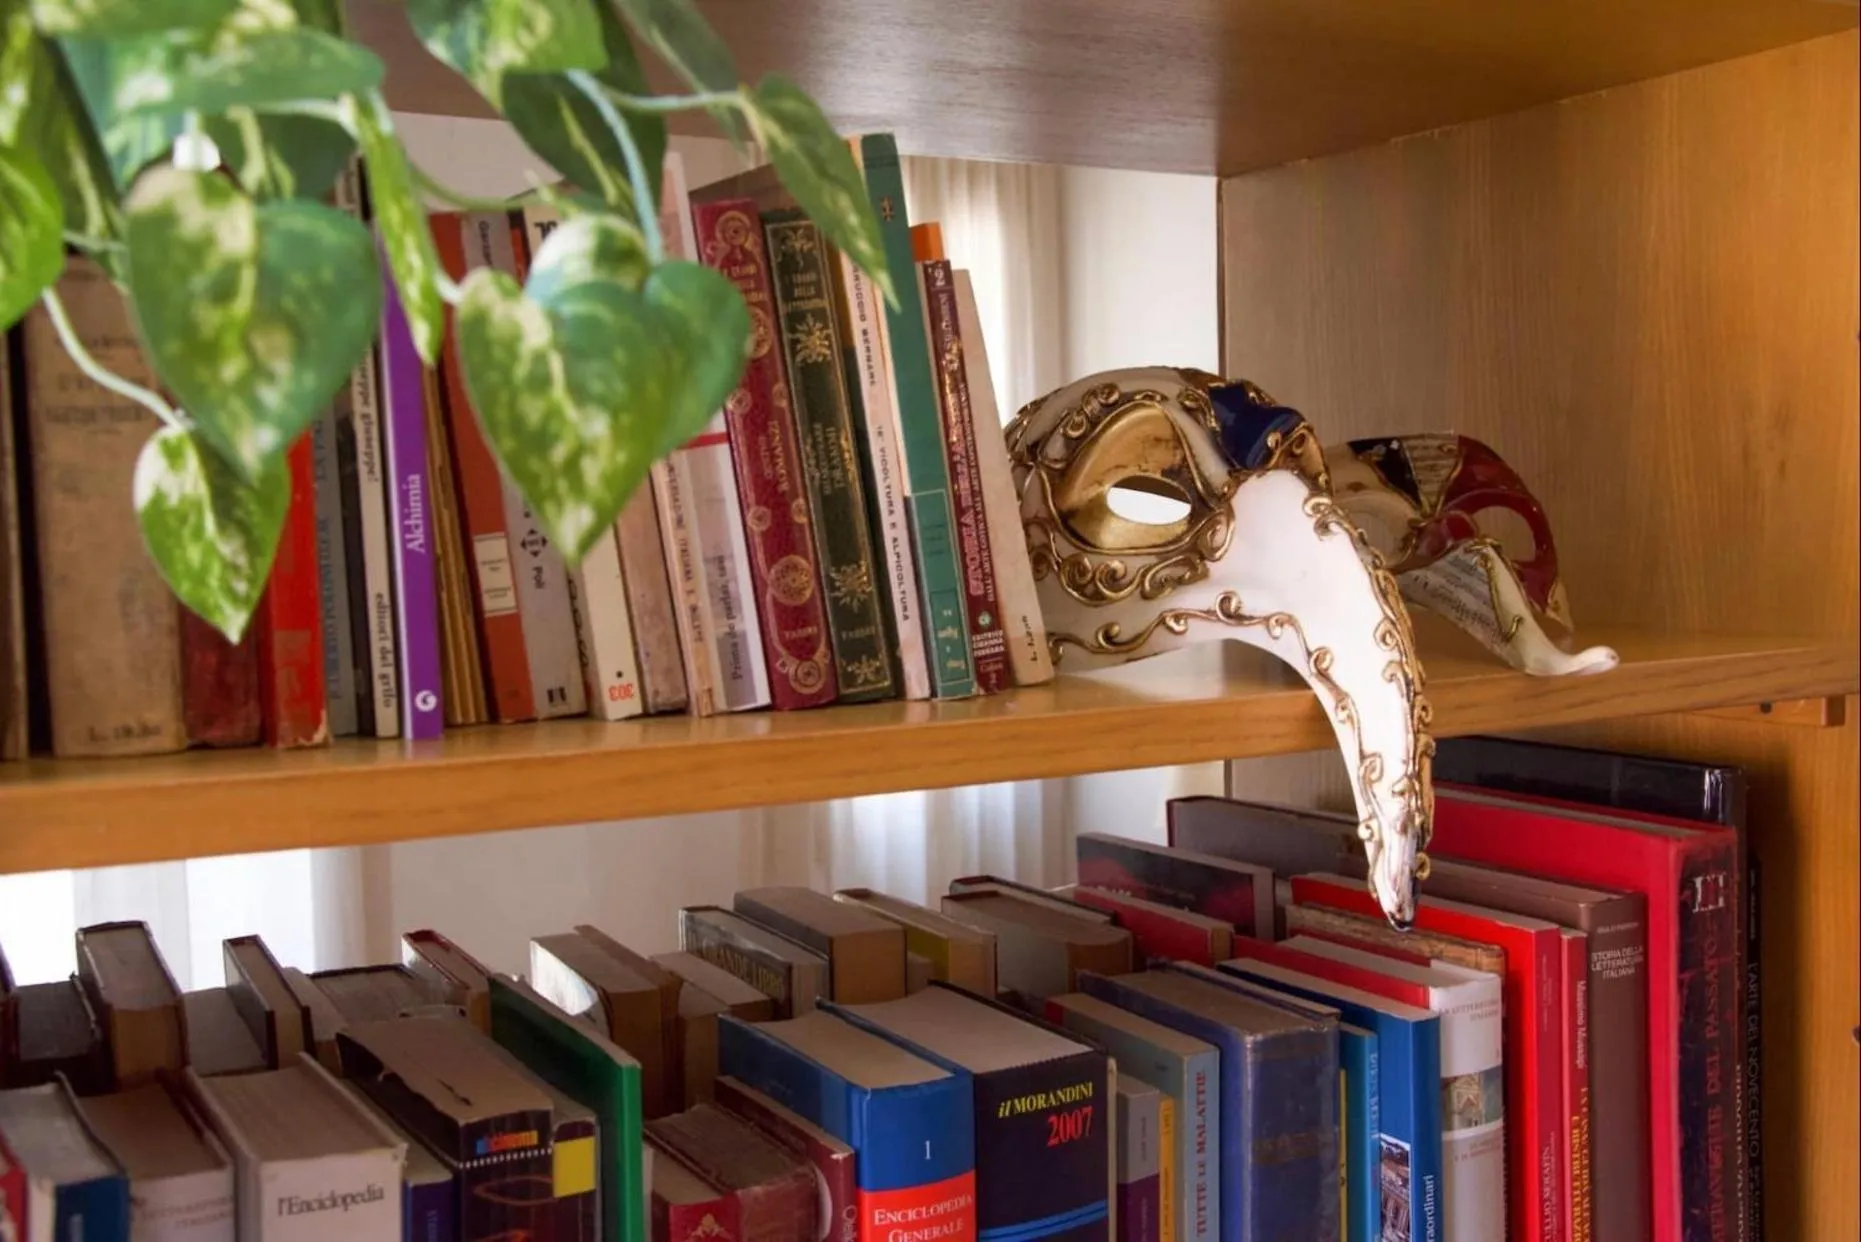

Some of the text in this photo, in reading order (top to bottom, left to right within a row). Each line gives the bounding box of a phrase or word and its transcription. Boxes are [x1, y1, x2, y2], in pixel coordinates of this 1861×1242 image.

[401, 473, 426, 553] Alchimia
[891, 535, 911, 622] ALPICOLTURA
[380, 645, 394, 668] del
[728, 641, 744, 680] Prima
[1704, 937, 1721, 1039] PASSATO
[1706, 1048, 1721, 1094] DEL
[998, 1081, 1093, 1118] il MORANDINI
[1195, 1071, 1207, 1155] MALATTIE
[1748, 1047, 1760, 1158] NOVECENTO
[1046, 1105, 1094, 1147] 2007
[873, 1192, 973, 1226] ENCICLOPEDIA
[888, 1217, 965, 1242] GENERALE
[1196, 1182, 1207, 1237] TUTTE
[1423, 1174, 1436, 1242] raordinari
